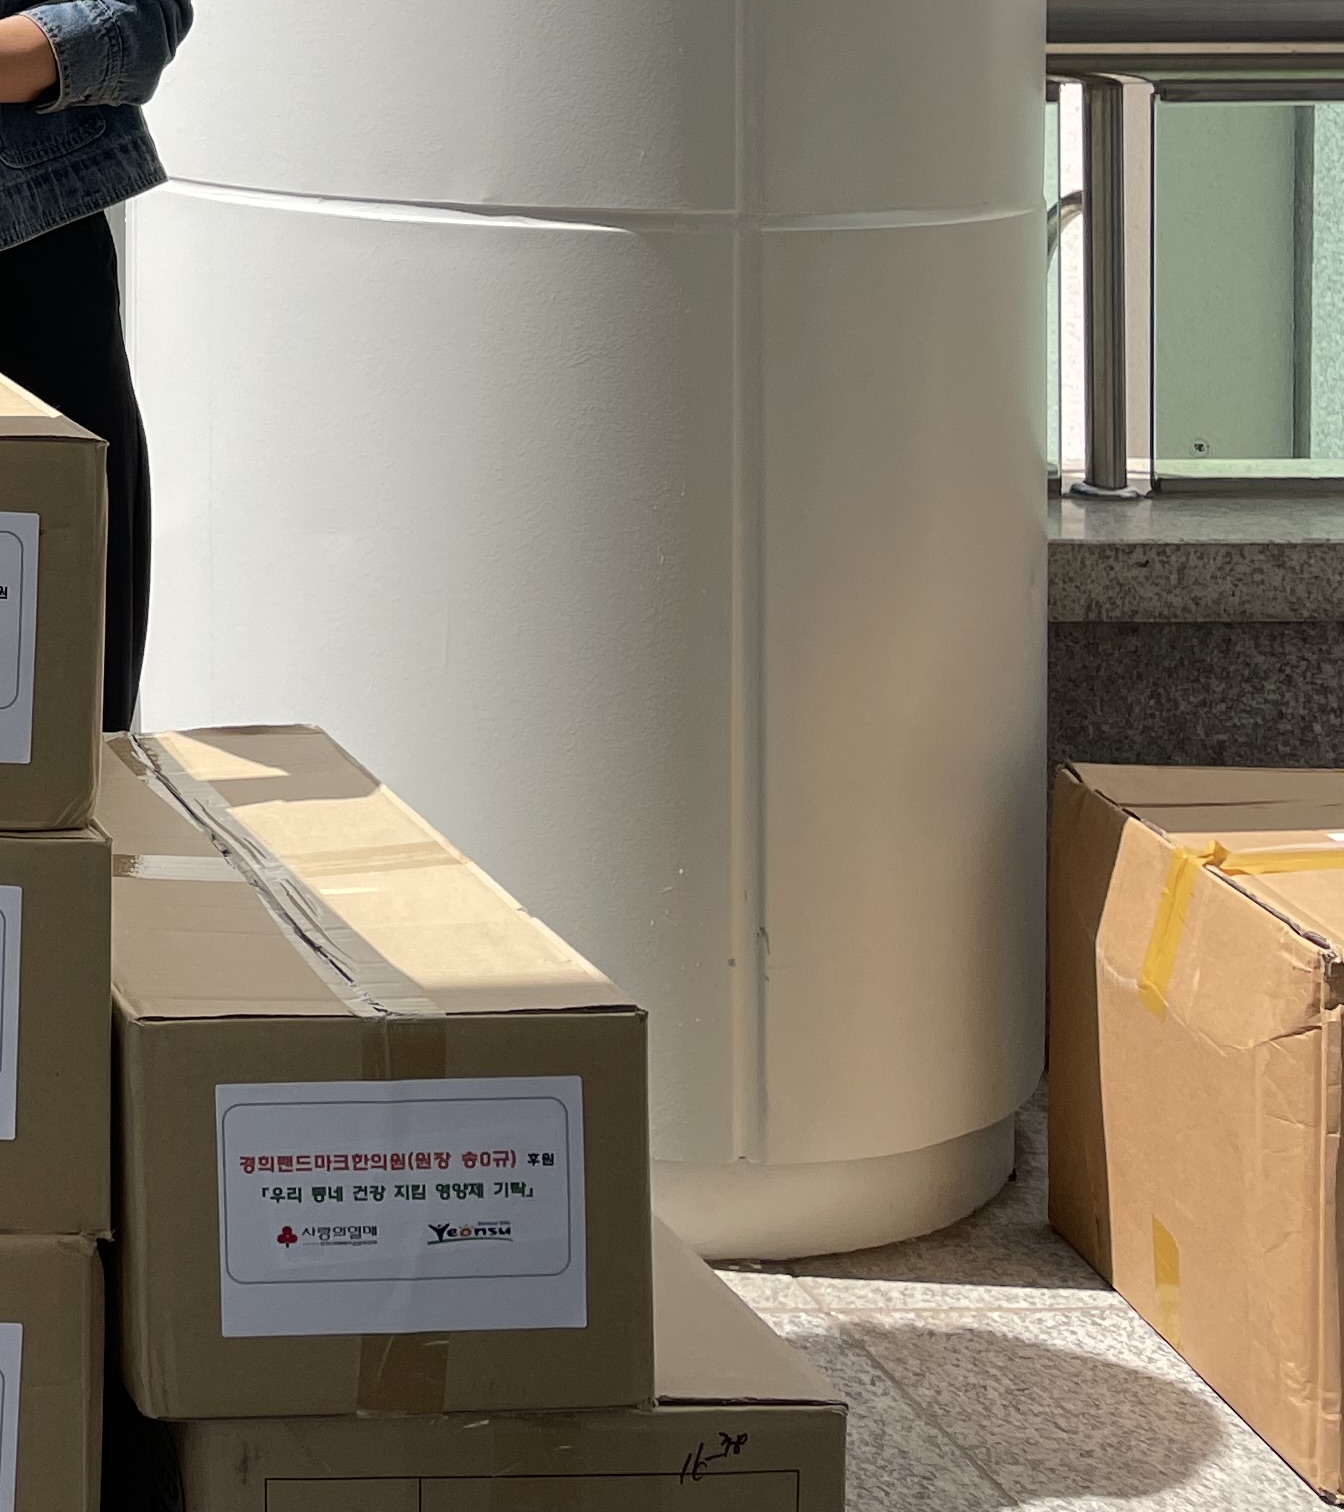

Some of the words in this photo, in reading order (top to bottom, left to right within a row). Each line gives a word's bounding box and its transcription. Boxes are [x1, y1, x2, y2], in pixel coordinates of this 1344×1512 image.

[527, 1152, 554, 1167] 후원
[311, 1185, 343, 1203] 동네
[352, 1184, 386, 1202] 건강
[393, 1183, 426, 1201] 지킴
[435, 1182, 484, 1200] 영양제
[428, 1222, 512, 1242] Yeonsu
